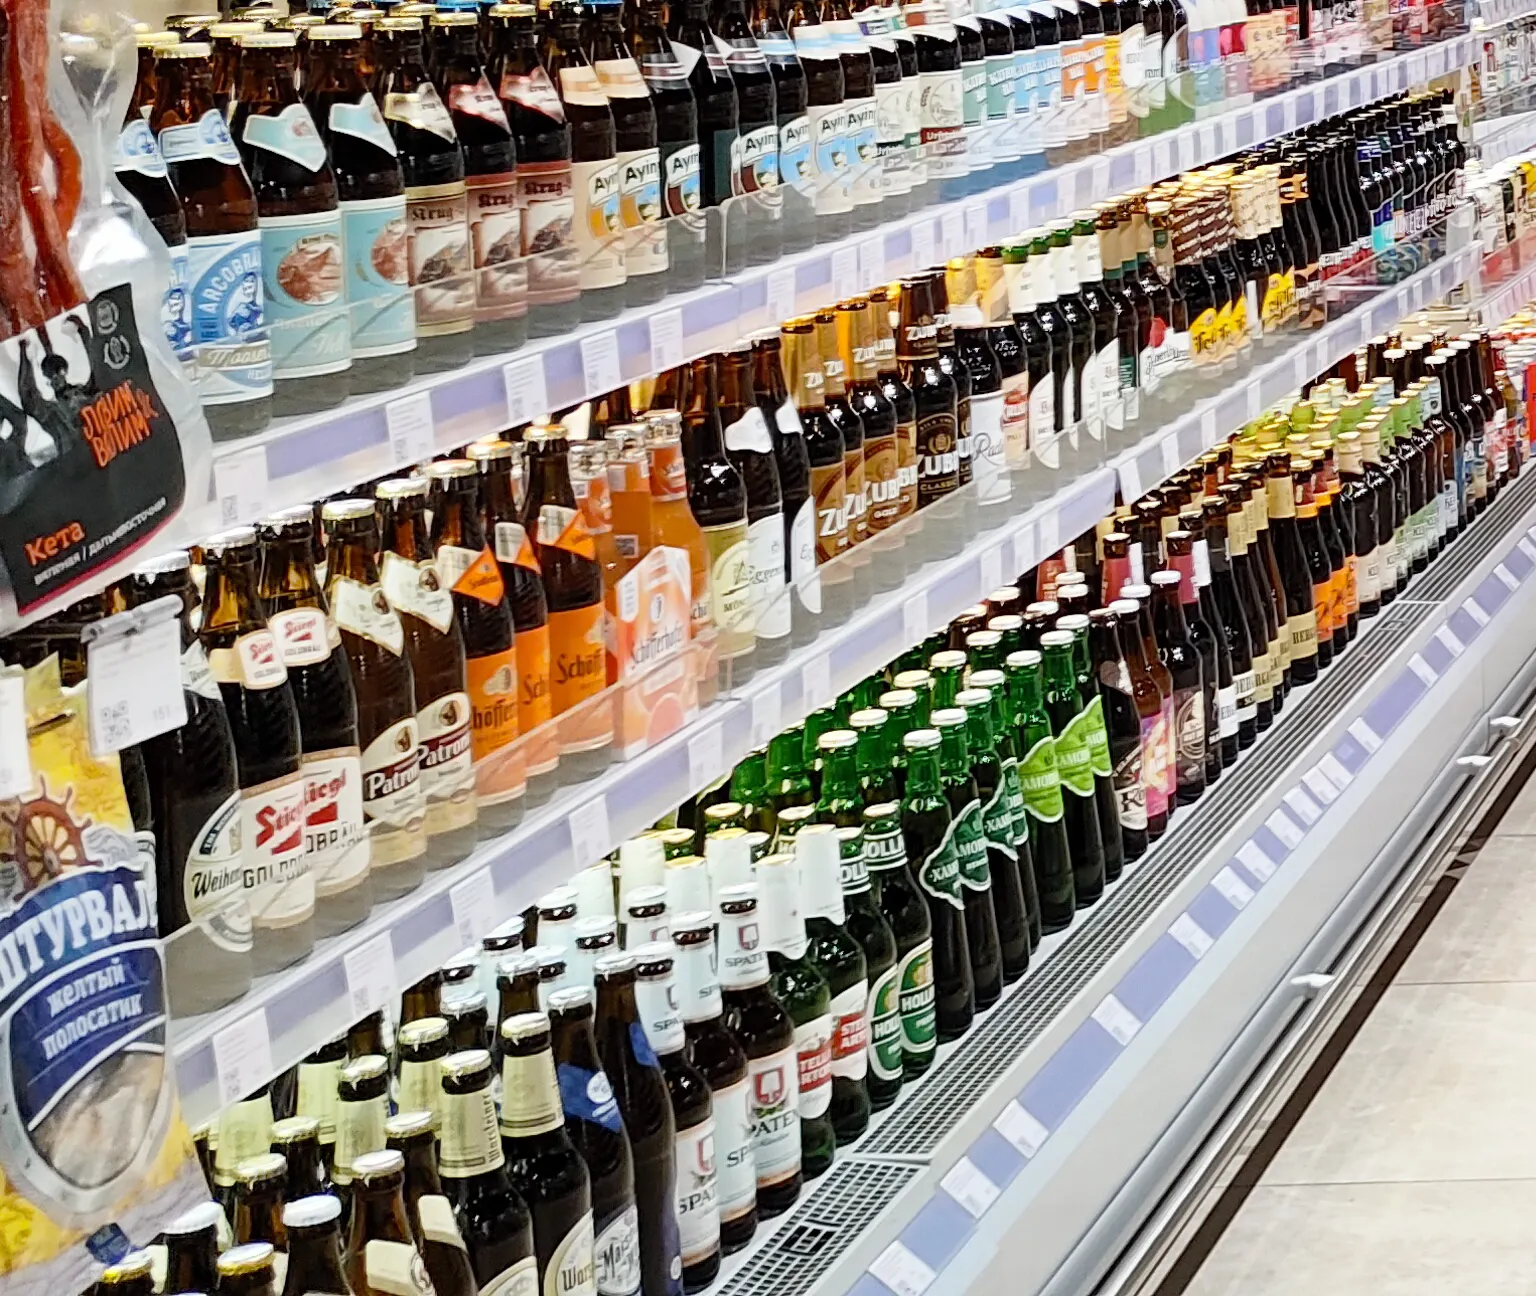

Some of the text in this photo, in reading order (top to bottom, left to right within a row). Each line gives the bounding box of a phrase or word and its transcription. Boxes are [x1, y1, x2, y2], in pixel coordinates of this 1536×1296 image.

[25, 521, 86, 567] Кета
[46, 956, 127, 1018] желтый
[41, 992, 144, 1062] полосатик
